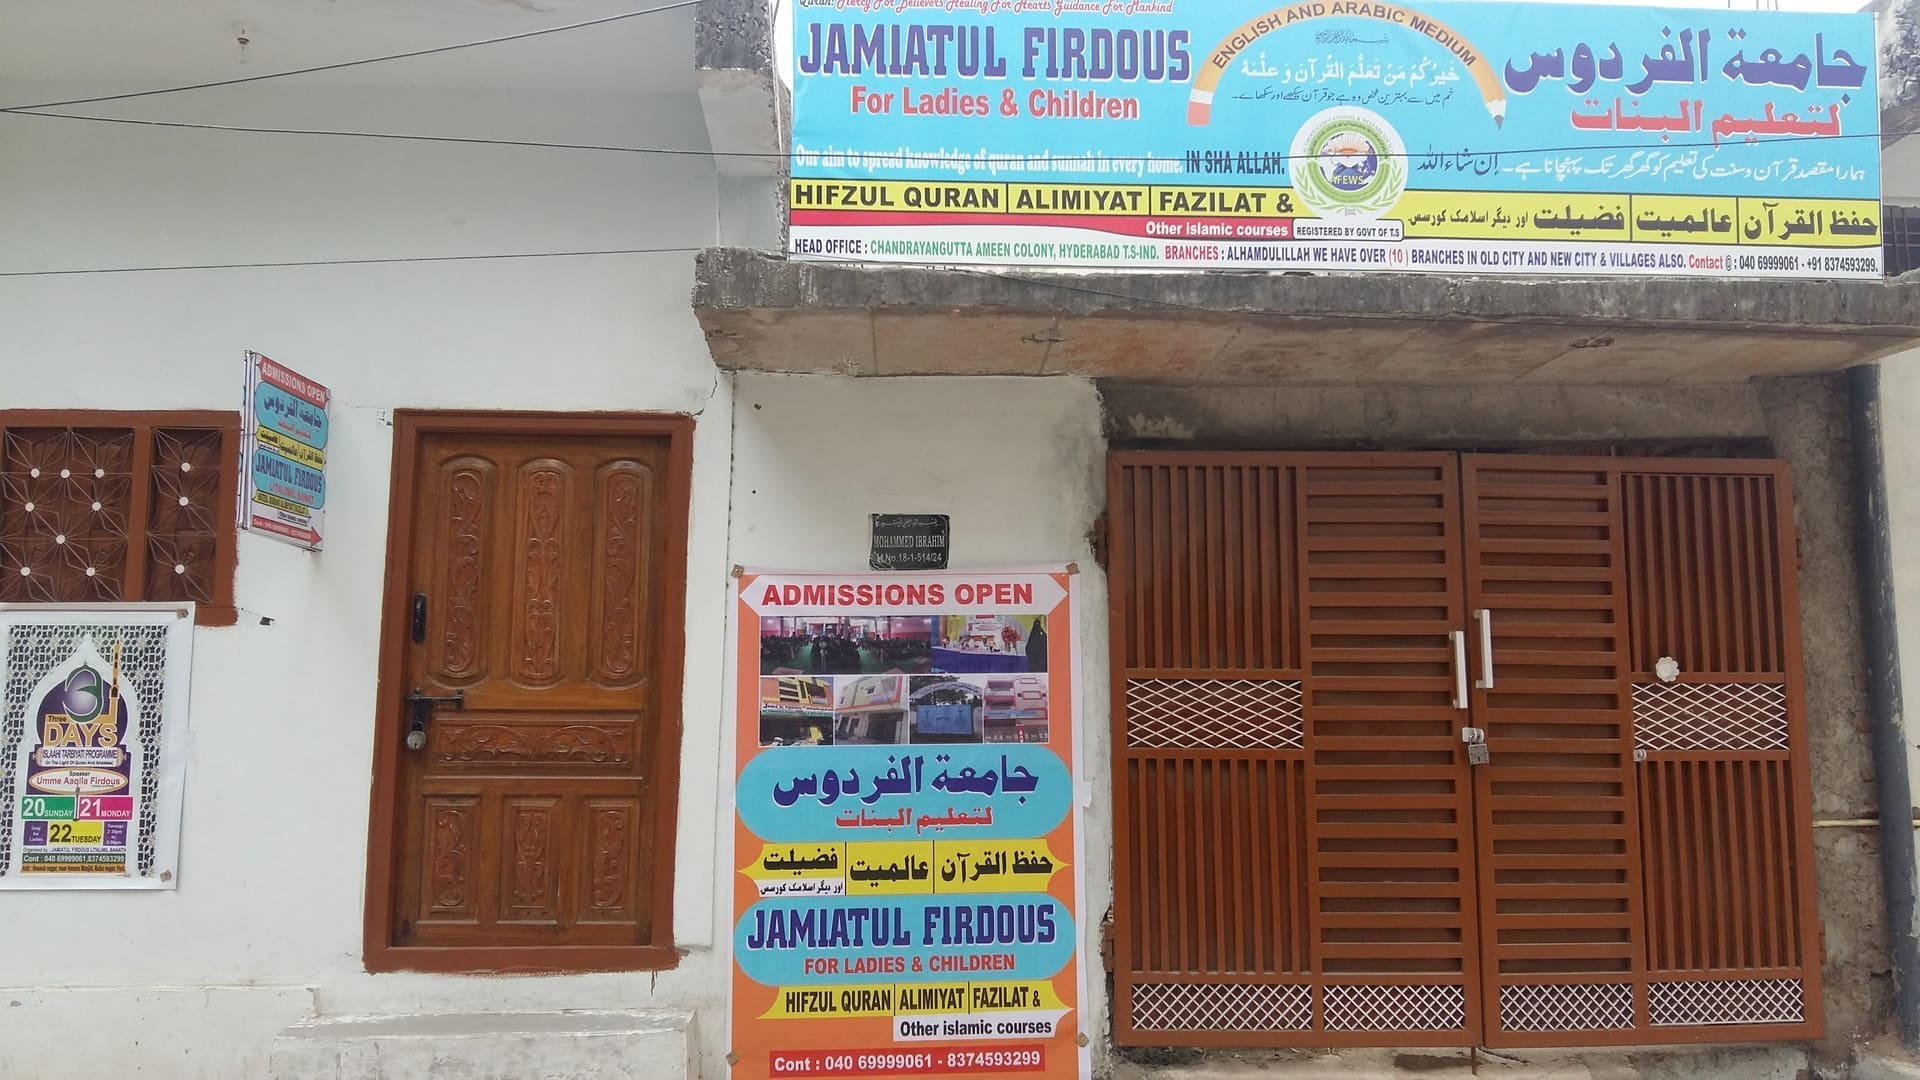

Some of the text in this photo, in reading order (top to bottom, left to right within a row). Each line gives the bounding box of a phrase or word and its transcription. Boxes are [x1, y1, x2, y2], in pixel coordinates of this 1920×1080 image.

[1054, 0, 1099, 16] Guidance
[1102, 0, 1123, 15] For
[1125, 0, 1172, 15] Mankind
[1212, 14, 1282, 69] ENGLISH
[1286, 3, 1325, 23] AND
[1332, 2, 1405, 23] ARABIC
[1409, 15, 1477, 66] MEDIUM
[800, 23, 1190, 81] JAMIATUL FIRDOUS
[1504, 25, 1867, 105] جامعة الفردوس
[851, 86, 1138, 118] For Ladies & Children
[1570, 97, 1840, 149] لتعليم البنات
[795, 144, 1285, 177] Our aim to spread knowledge of quran and sunnah in every home. IN SHA ALLAH.
[795, 184, 999, 209] HIFZUL QURAN
[1016, 189, 1143, 212] ALIMIYAT
[1159, 191, 1294, 213] FAZILAT &
[1145, 221, 1288, 237] Other islamic courses
[1515, 210, 1528, 227] اور
[1744, 201, 1878, 241] حفظ القرآن
[1296, 226, 1400, 239] REGISTERED BY GOVT OF T.S
[795, 238, 822, 253] HEAD
[825, 239, 862, 254] OFFICE
[870, 240, 973, 256] CHANDRAYANGUTTA
[975, 241, 1010, 257] AMEEN
[1013, 242, 1057, 261] COLONY,
[1059, 243, 1120, 260] HYDERABAD
[1165, 245, 1219, 261] BRANCHES
[1227, 246, 1310, 262] ALHAMDULILLAH
[1313, 246, 1328, 262] WE
[1330, 247, 1357, 263] HAVE
[1359, 247, 1386, 263] OVER
[1411, 248, 1465, 265] BRANCHES
[1467, 250, 1478, 265] IN
[1480, 250, 1500, 265] OLD
[1502, 251, 1525, 266] CITY
[1527, 251, 1548, 267] AND
[1550, 252, 1572, 267] NEW
[1574, 252, 1597, 267] CITY
[1600, 252, 1607, 267] &
[1609, 252, 1656, 269] VILLAGES
[1658, 253, 1687, 269] ALSO.
[1689, 253, 1724, 270] Contact
[1739, 255, 1755, 270] 040
[1757, 255, 1799, 272] 69999061
[1806, 256, 1822, 272] +91
[1824, 257, 1878, 273] 8374593299.
[261, 362, 326, 404] ADMISSIONS OPEN
[255, 452, 323, 495] JAMIATUL FIRDOUS
[873, 535, 945, 548] MOHAMMED IBRAHIM
[761, 583, 1033, 607] ADMISSIONS OPEN
[47, 715, 67, 723] Three
[43, 722, 118, 747] DAYS
[86, 749, 117, 759] PROGRAMME
[36, 777, 62, 785] Umme
[90, 776, 120, 785] Firdous
[773, 754, 1039, 806] جامعة الفردوس
[22, 798, 74, 817] 20 SUNDAY
[80, 798, 131, 817] 21 MONDAY
[835, 807, 993, 835] لتعليم البنات
[49, 824, 102, 843] 22 TUESDAY
[941, 850, 1053, 884] حفظ القرآن
[747, 904, 1056, 950] JAMIATUL FIRDOUS
[804, 954, 1015, 975] FOR LADIES & CHILDREN
[785, 990, 892, 1013] HIFZUL QURAN
[899, 988, 965, 1010] ALIMIYAT
[973, 986, 1041, 1009] FAZILAT &
[900, 1019, 1052, 1037] Other islamic courses
[775, 1051, 1041, 1071] Cont 040 69999061 8374593299
